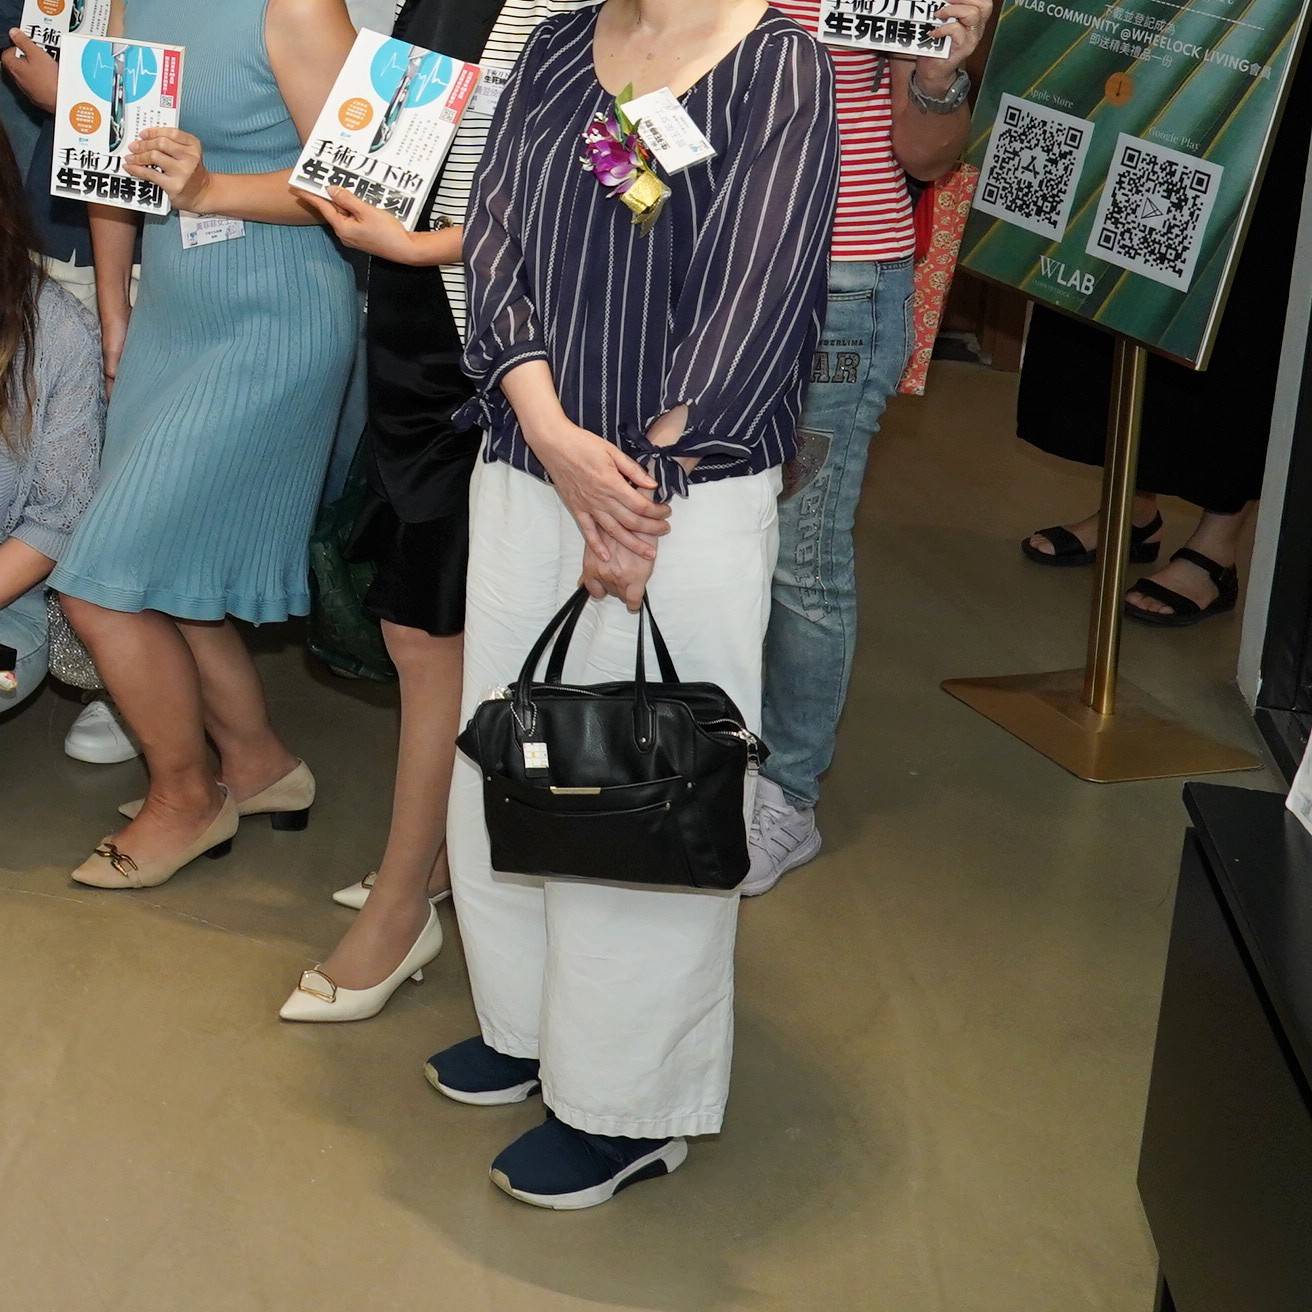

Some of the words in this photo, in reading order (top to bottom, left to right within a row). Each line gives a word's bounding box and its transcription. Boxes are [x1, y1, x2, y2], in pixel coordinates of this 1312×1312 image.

[1047, 3, 1120, 35] COMMUNITY
[1120, 27, 1203, 59] @WHEELOCK
[1052, 94, 1074, 109] Store
[312, 139, 424, 191] 手術刀下的
[55, 167, 164, 209] 生死時刻
[1040, 255, 1095, 295] WLAB
